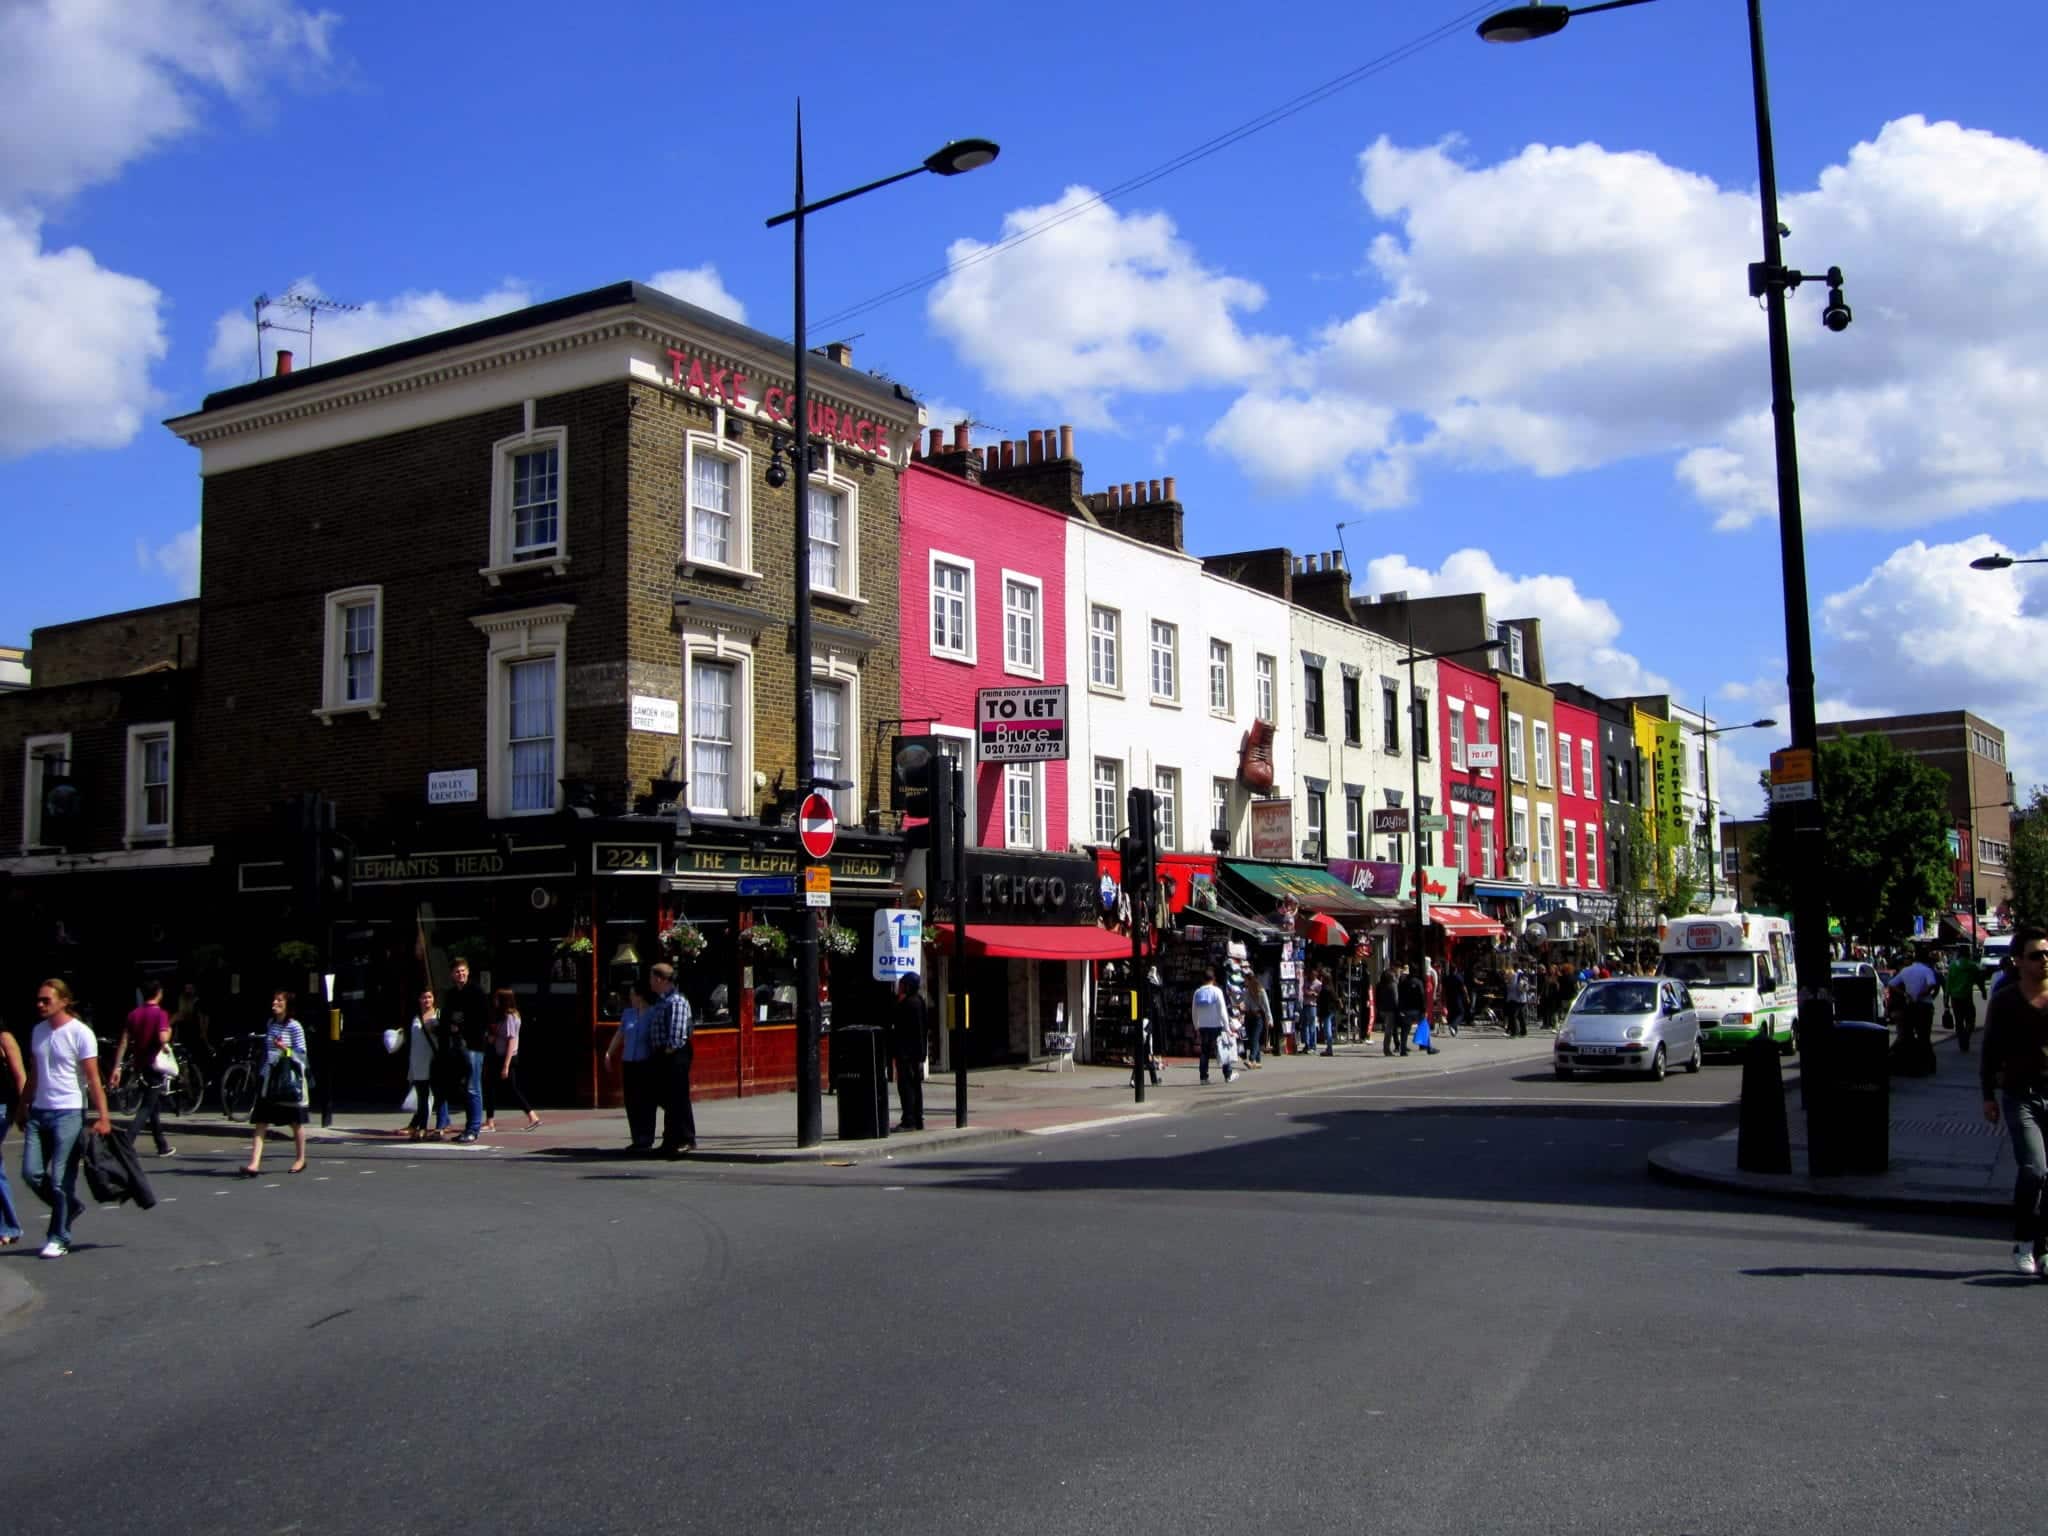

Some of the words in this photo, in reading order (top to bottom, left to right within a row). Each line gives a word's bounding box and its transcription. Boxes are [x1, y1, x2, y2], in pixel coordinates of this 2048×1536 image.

[666, 347, 748, 409] TAKE
[633, 706, 658, 718] CAMDEN
[985, 699, 1017, 719] TO
[1024, 698, 1058, 718] LET
[996, 723, 1050, 742] Bruce
[984, 744, 1004, 755] 020
[1007, 743, 1031, 754] 7267
[1034, 742, 1060, 753] 6772
[1471, 751, 1480, 759] TO
[1481, 750, 1494, 759] LET
[431, 780, 463, 790] HAWLEY
[1671, 755, 1683, 828] TATTOO
[430, 789, 467, 801] CRESCENT
[353, 857, 440, 879] LEPHANTS
[455, 855, 504, 875] HEAD
[606, 849, 650, 869] 224
[692, 851, 725, 870] THE
[840, 857, 880, 876] HEAD
[879, 956, 915, 967] OPEN
